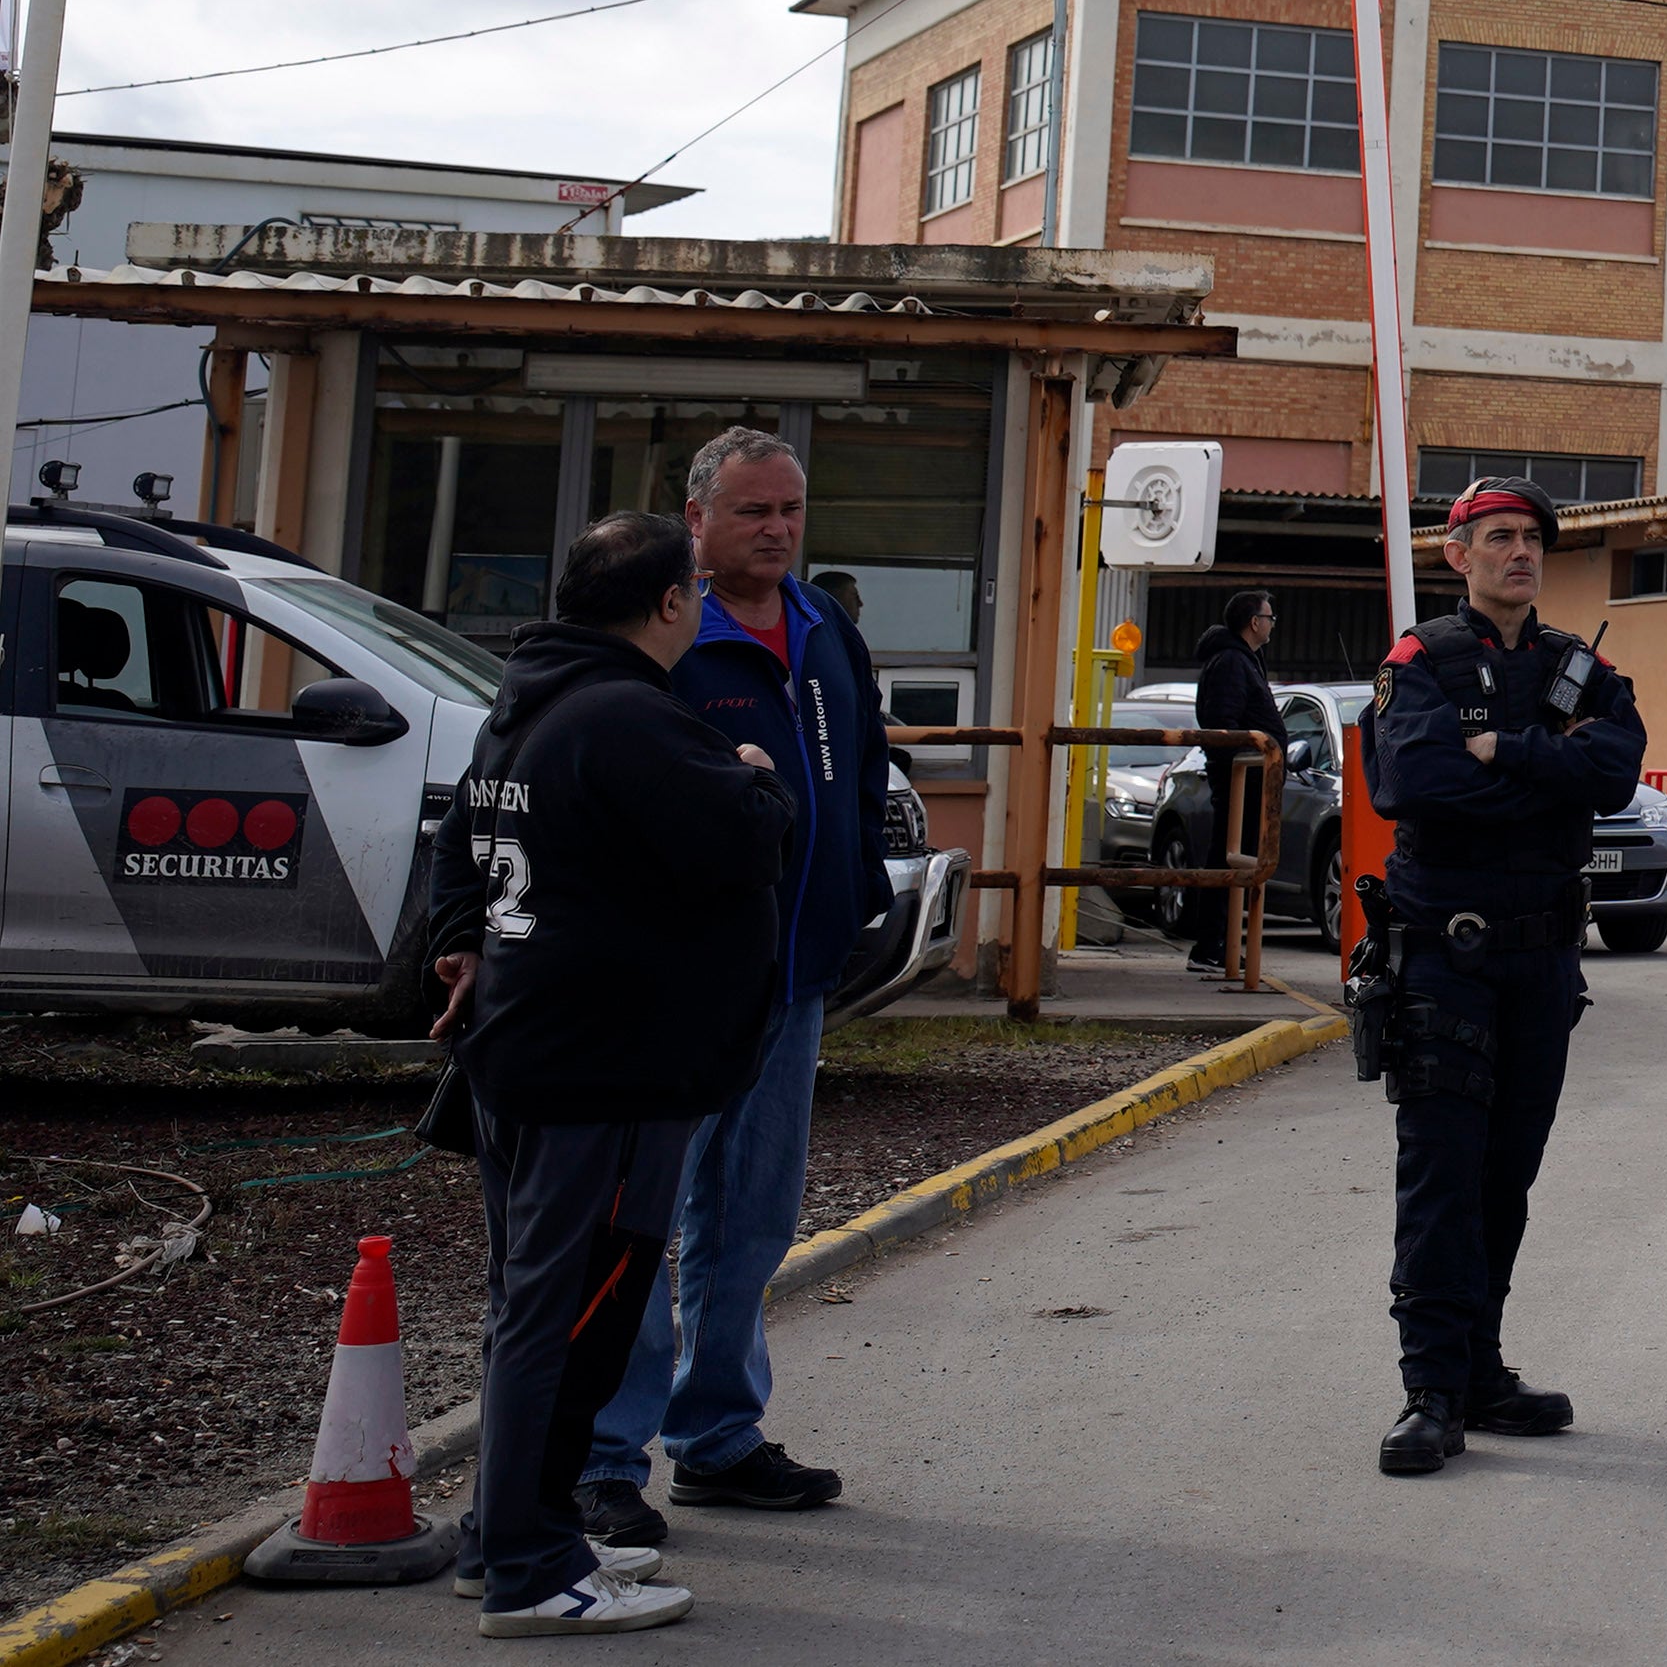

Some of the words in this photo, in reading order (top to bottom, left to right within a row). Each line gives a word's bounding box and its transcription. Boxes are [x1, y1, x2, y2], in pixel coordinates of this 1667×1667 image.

[808, 679, 829, 741] Motorrad
[1460, 708, 1488, 721] LICI
[820, 744, 834, 781] BMW
[124, 853, 289, 880] SECURITAS
